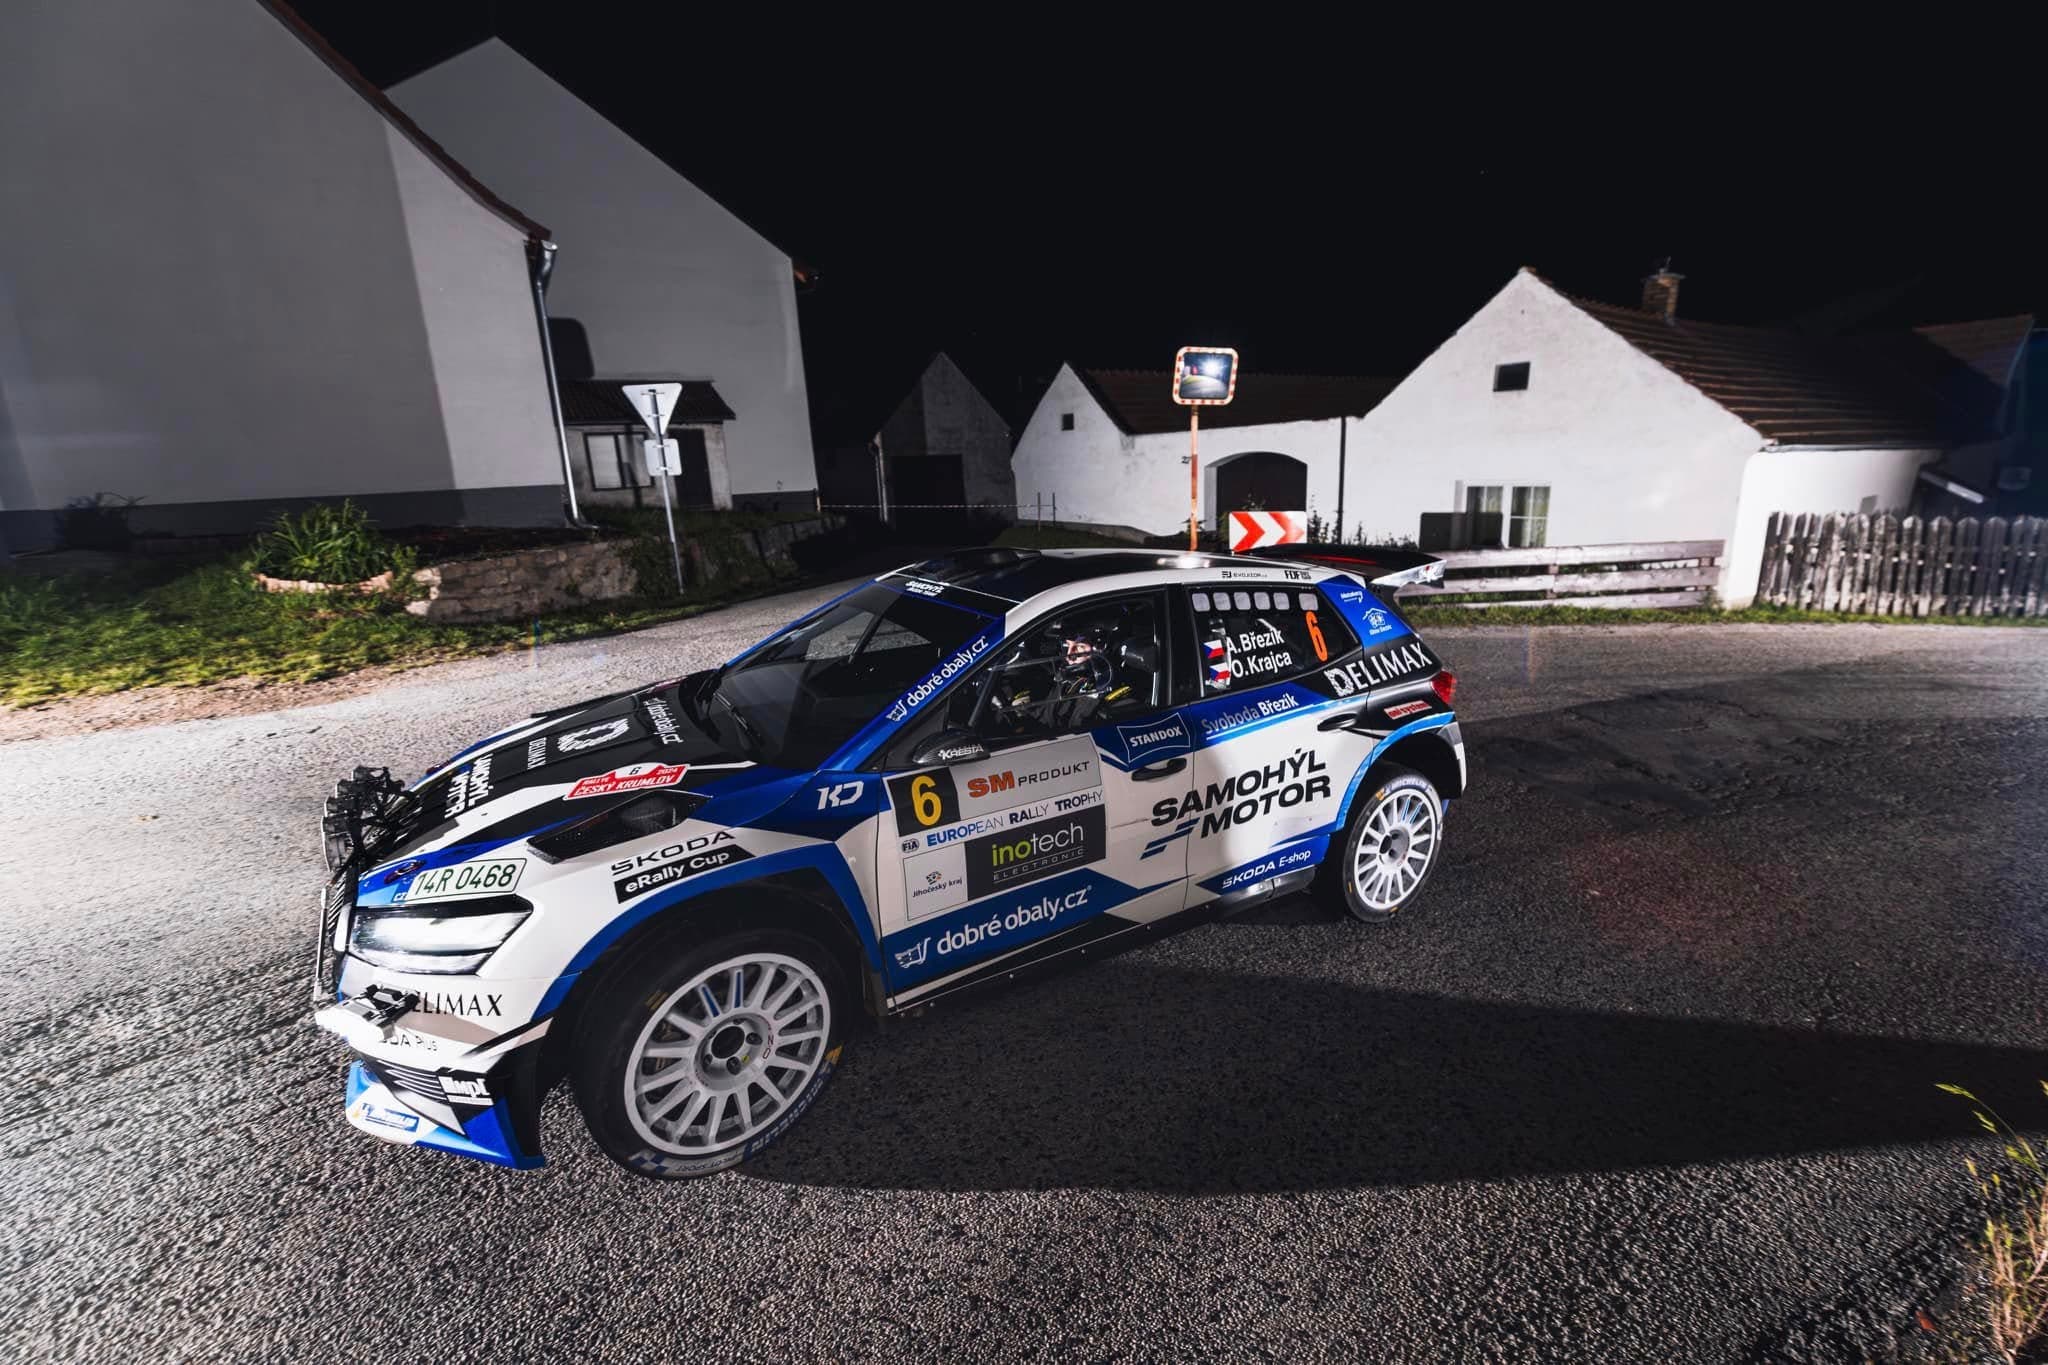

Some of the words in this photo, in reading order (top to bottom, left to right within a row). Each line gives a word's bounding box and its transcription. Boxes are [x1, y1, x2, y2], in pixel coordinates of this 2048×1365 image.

[1305, 610, 1329, 662] 6
[906, 672, 944, 707] dobré
[940, 637, 989, 679] obaly.cz
[1323, 642, 1433, 697] DELIMAX
[1129, 726, 1183, 747] STANDOX
[1201, 705, 1261, 735] Svoboda
[616, 775, 674, 790] KRUMLOV
[967, 770, 1016, 798] SM
[1017, 760, 1090, 787] PRODUKT
[1151, 748, 1327, 827] SAMOHÝL
[910, 775, 943, 827] 6
[926, 815, 1004, 847] EUROPEAN
[1008, 802, 1050, 825] RALLY
[1054, 789, 1104, 812] TROPHY
[1200, 775, 1332, 839] MOTOR
[903, 841, 919, 852] FIA
[991, 821, 1085, 867] inotech
[993, 848, 1085, 881] ELECTRONIC
[1279, 849, 1311, 868] E-shop
[455, 863, 517, 890] 0468
[625, 864, 685, 893] eRally
[689, 851, 730, 869] Cup
[936, 913, 1002, 955] dobré
[412, 992, 503, 1017] LIMAX
